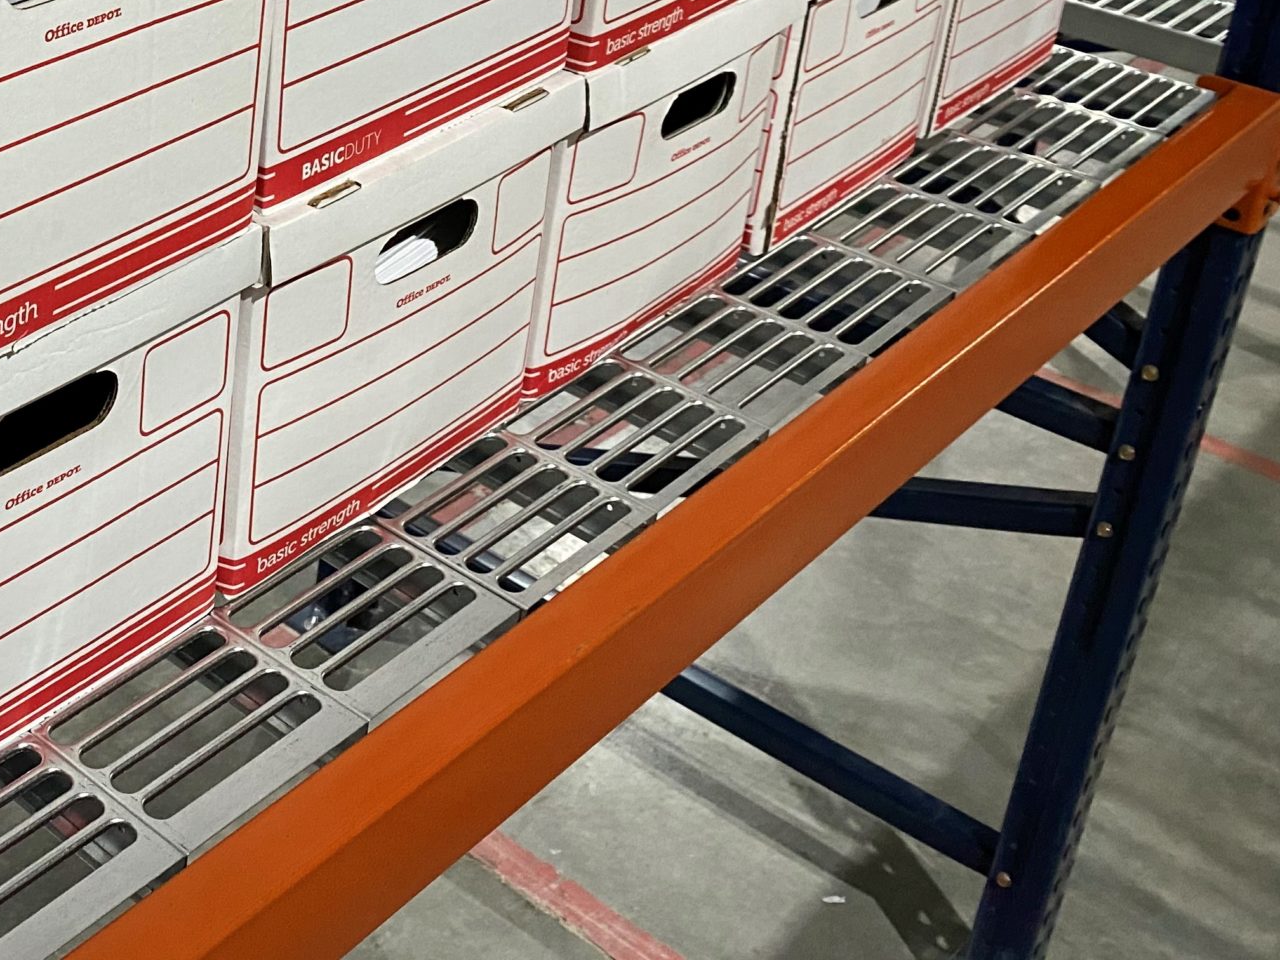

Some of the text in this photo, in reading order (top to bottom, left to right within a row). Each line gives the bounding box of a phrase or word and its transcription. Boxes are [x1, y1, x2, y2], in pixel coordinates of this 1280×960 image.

[44, 21, 84, 43] Office
[605, 5, 684, 56] basic strength
[301, 128, 383, 181] BASICDUTY
[396, 288, 424, 309] Office
[548, 357, 582, 384] basic
[4, 484, 44, 511] Office
[256, 498, 361, 574] basic strength
